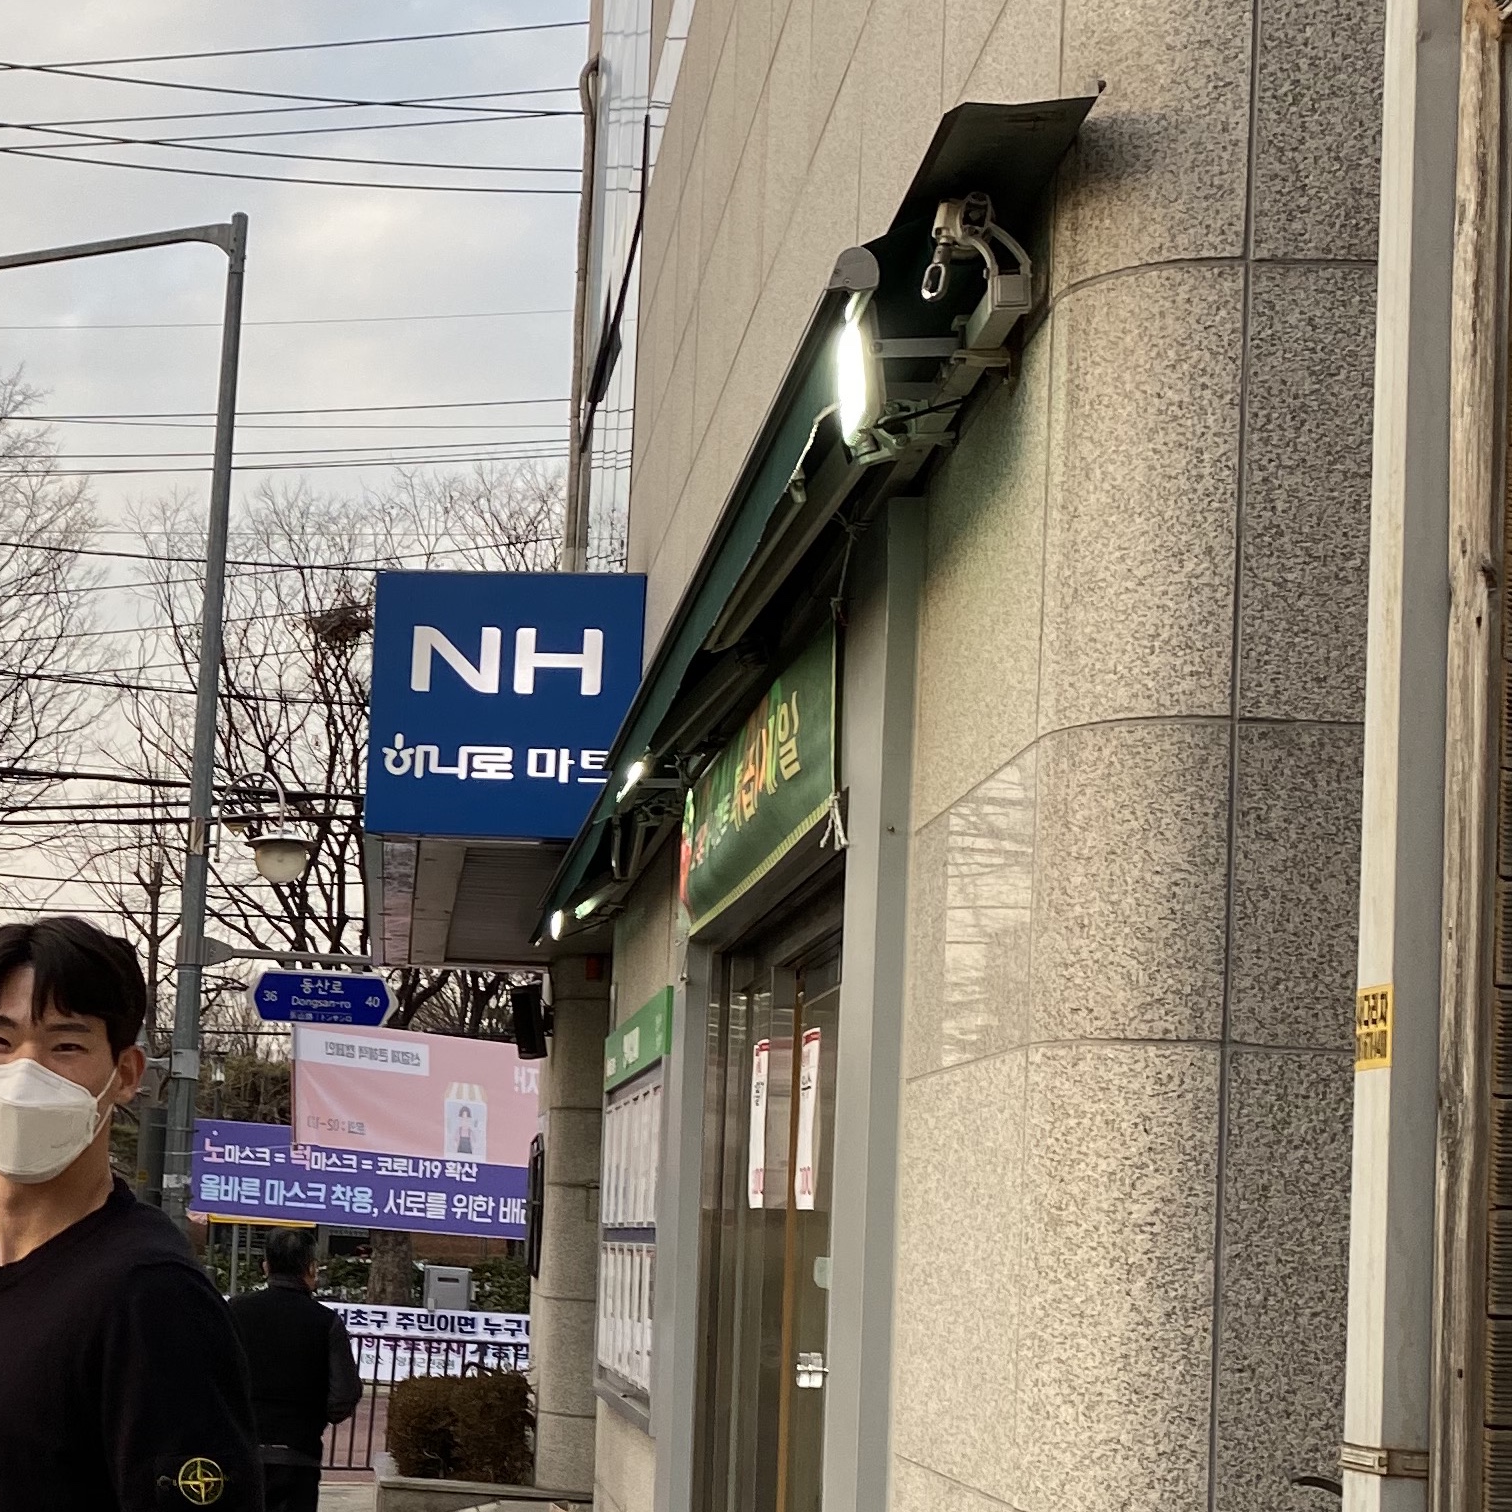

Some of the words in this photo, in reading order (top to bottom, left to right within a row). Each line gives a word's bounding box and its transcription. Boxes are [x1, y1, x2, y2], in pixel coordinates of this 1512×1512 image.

[410, 625, 604, 696] NH
[381, 732, 514, 781] 하나로
[262, 989, 278, 1002] 36
[291, 996, 352, 1009] Dongsan-ro
[364, 996, 381, 1008] 40
[300, 978, 345, 995] 동산로
[202, 1138, 271, 1167] 노마스크
[375, 1157, 442, 1180] 코로나19
[444, 1161, 478, 1183] 확산
[199, 1174, 261, 1205] 올바른
[264, 1178, 327, 1210] 마스크
[330, 1183, 378, 1218] 착용,
[382, 1188, 447, 1220] 서로를
[450, 1194, 496, 1225] 위한
[395, 1312, 477, 1334] 주민이면
